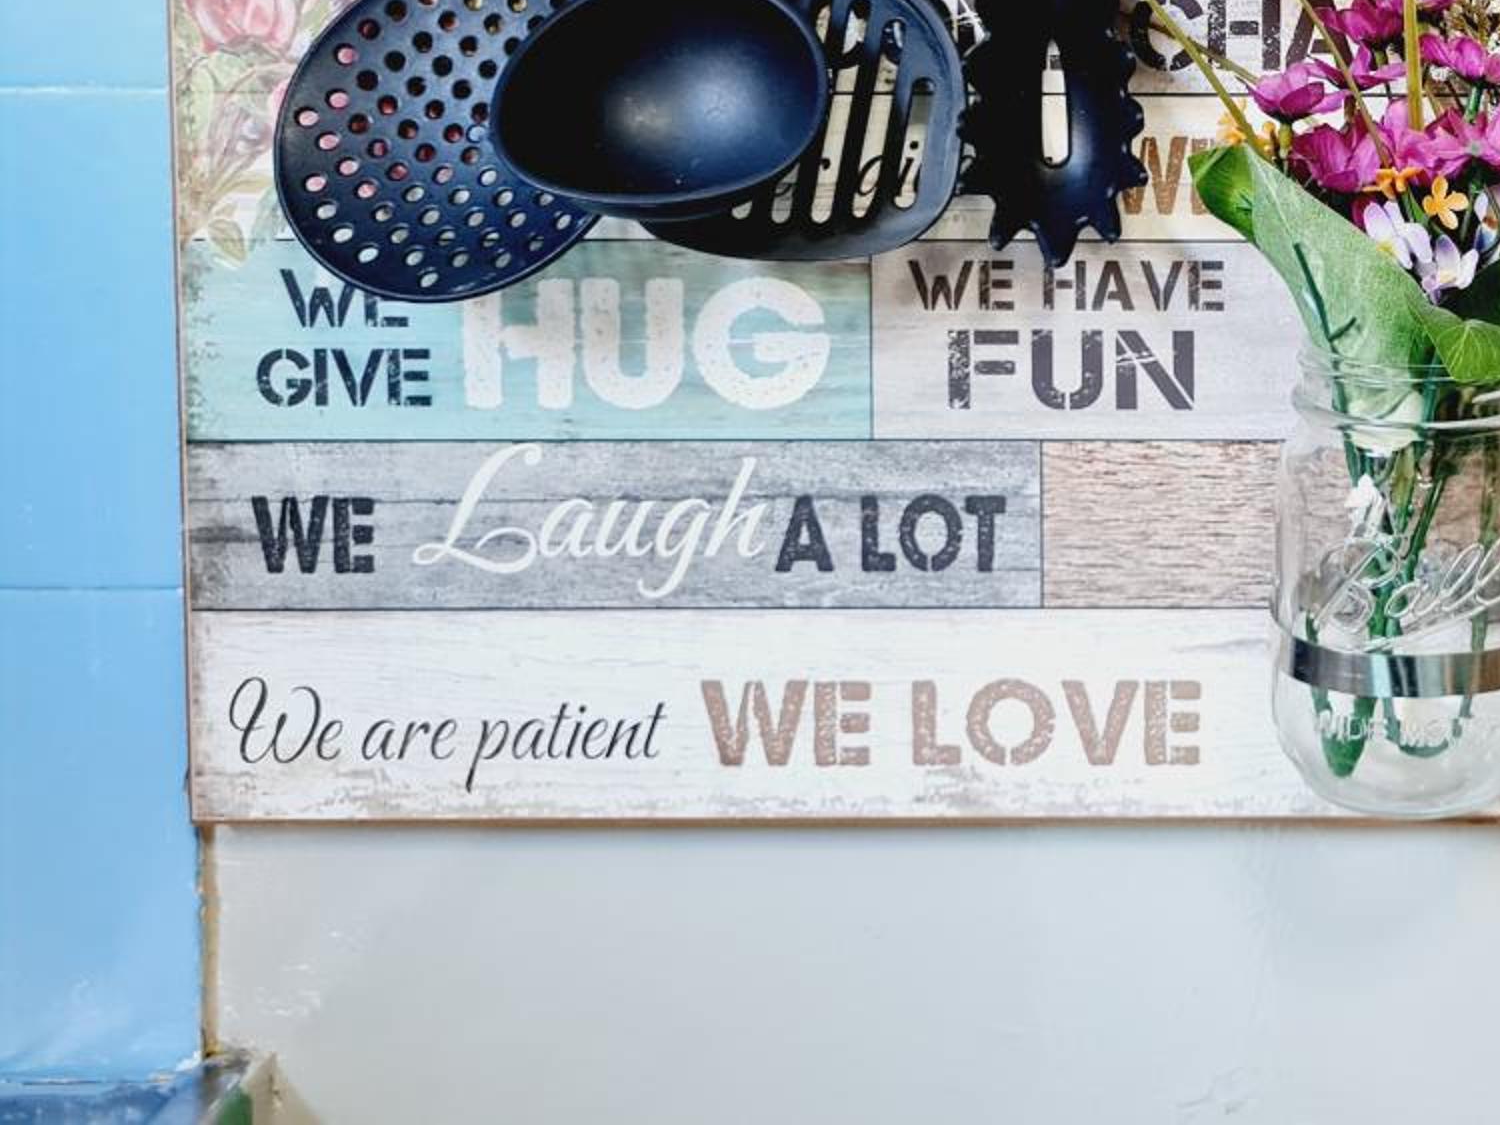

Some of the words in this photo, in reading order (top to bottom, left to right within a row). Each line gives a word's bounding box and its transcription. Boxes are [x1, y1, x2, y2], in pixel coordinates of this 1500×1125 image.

[280, 269, 409, 327] WE
[908, 260, 1015, 311] WE
[1043, 260, 1225, 311] HAVE
[256, 348, 432, 407] GIVE
[463, 277, 831, 410] HUG
[947, 330, 1195, 410] FUN
[251, 495, 375, 574] WE
[412, 443, 767, 599] Laugh
[775, 494, 834, 572] A
[860, 494, 1007, 572] LOT
[229, 676, 343, 764] We
[361, 719, 458, 761] are
[464, 702, 668, 793] patient
[700, 680, 871, 765] WE
[911, 678, 1202, 765] LOVE
